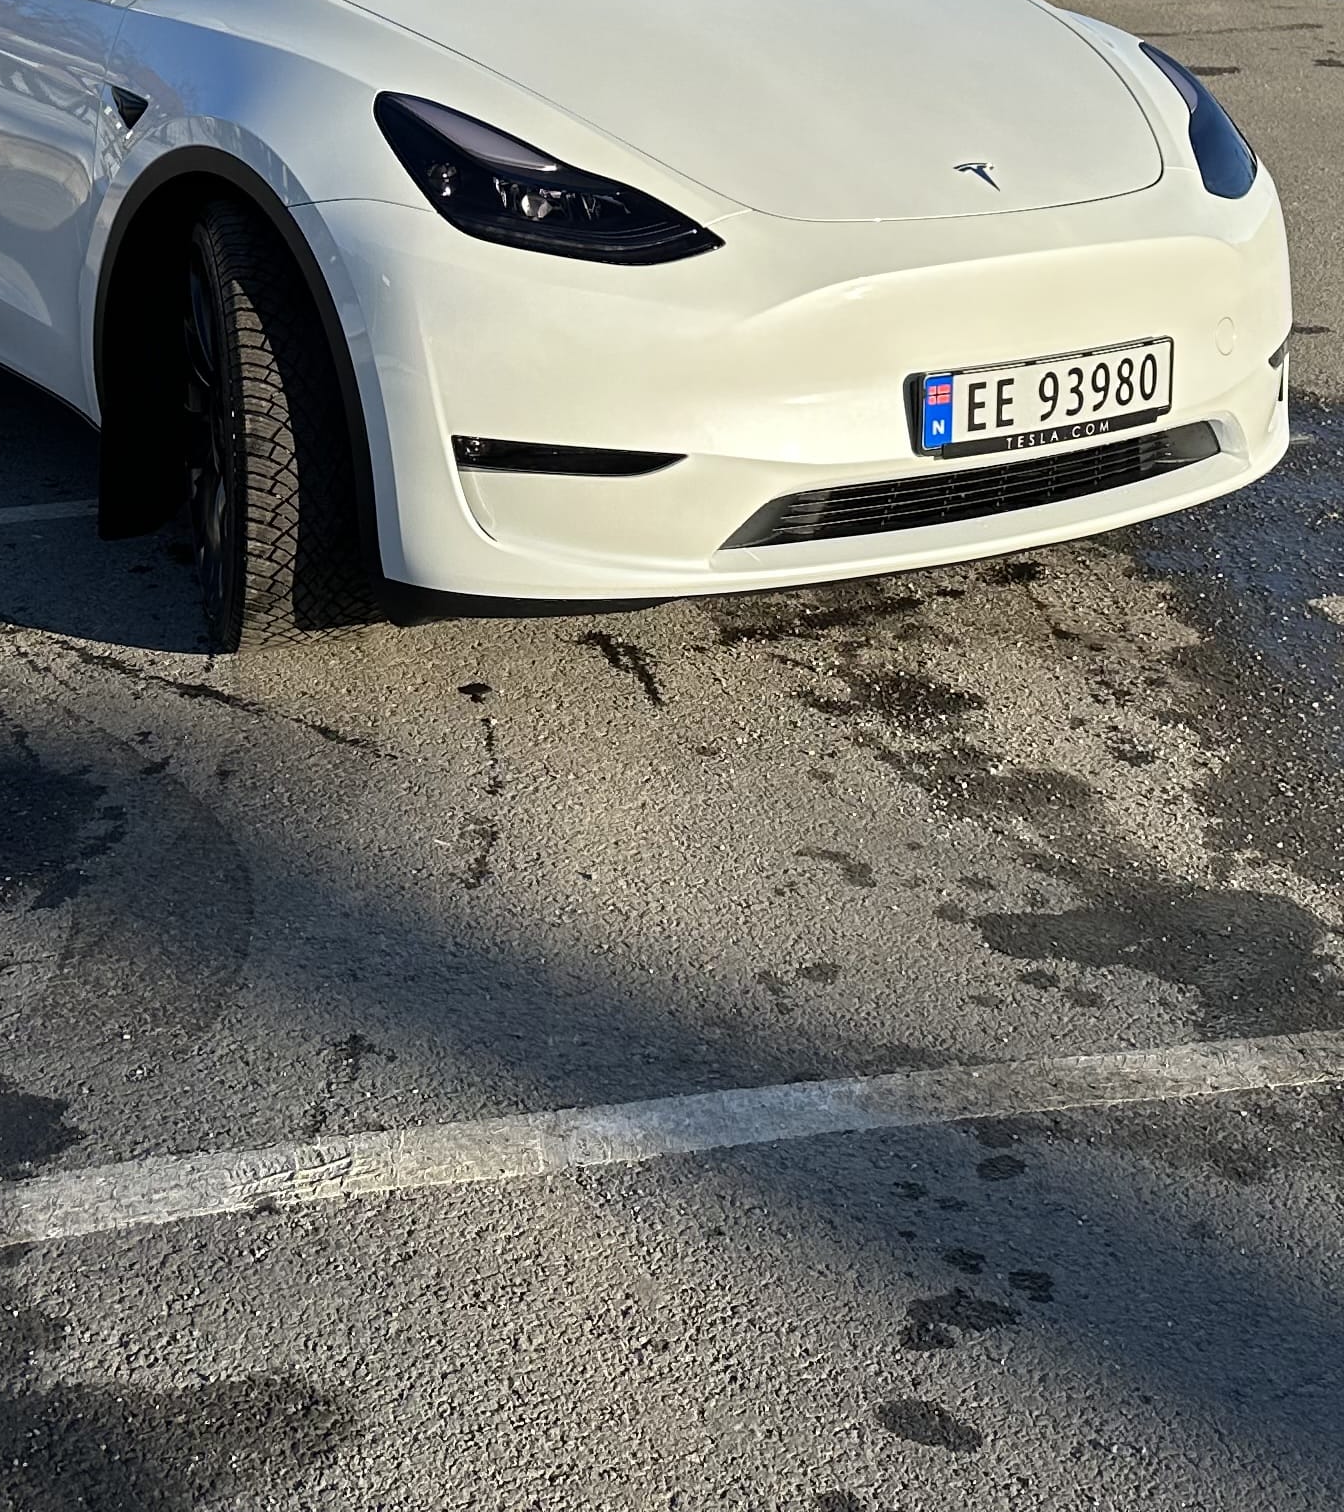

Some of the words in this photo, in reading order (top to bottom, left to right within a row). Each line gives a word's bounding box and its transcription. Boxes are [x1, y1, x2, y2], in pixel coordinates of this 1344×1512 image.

[967, 378, 1015, 432] EE
[1038, 353, 1158, 420] 93980
[931, 419, 945, 435] N
[1006, 420, 1110, 449] TESLA.COM
